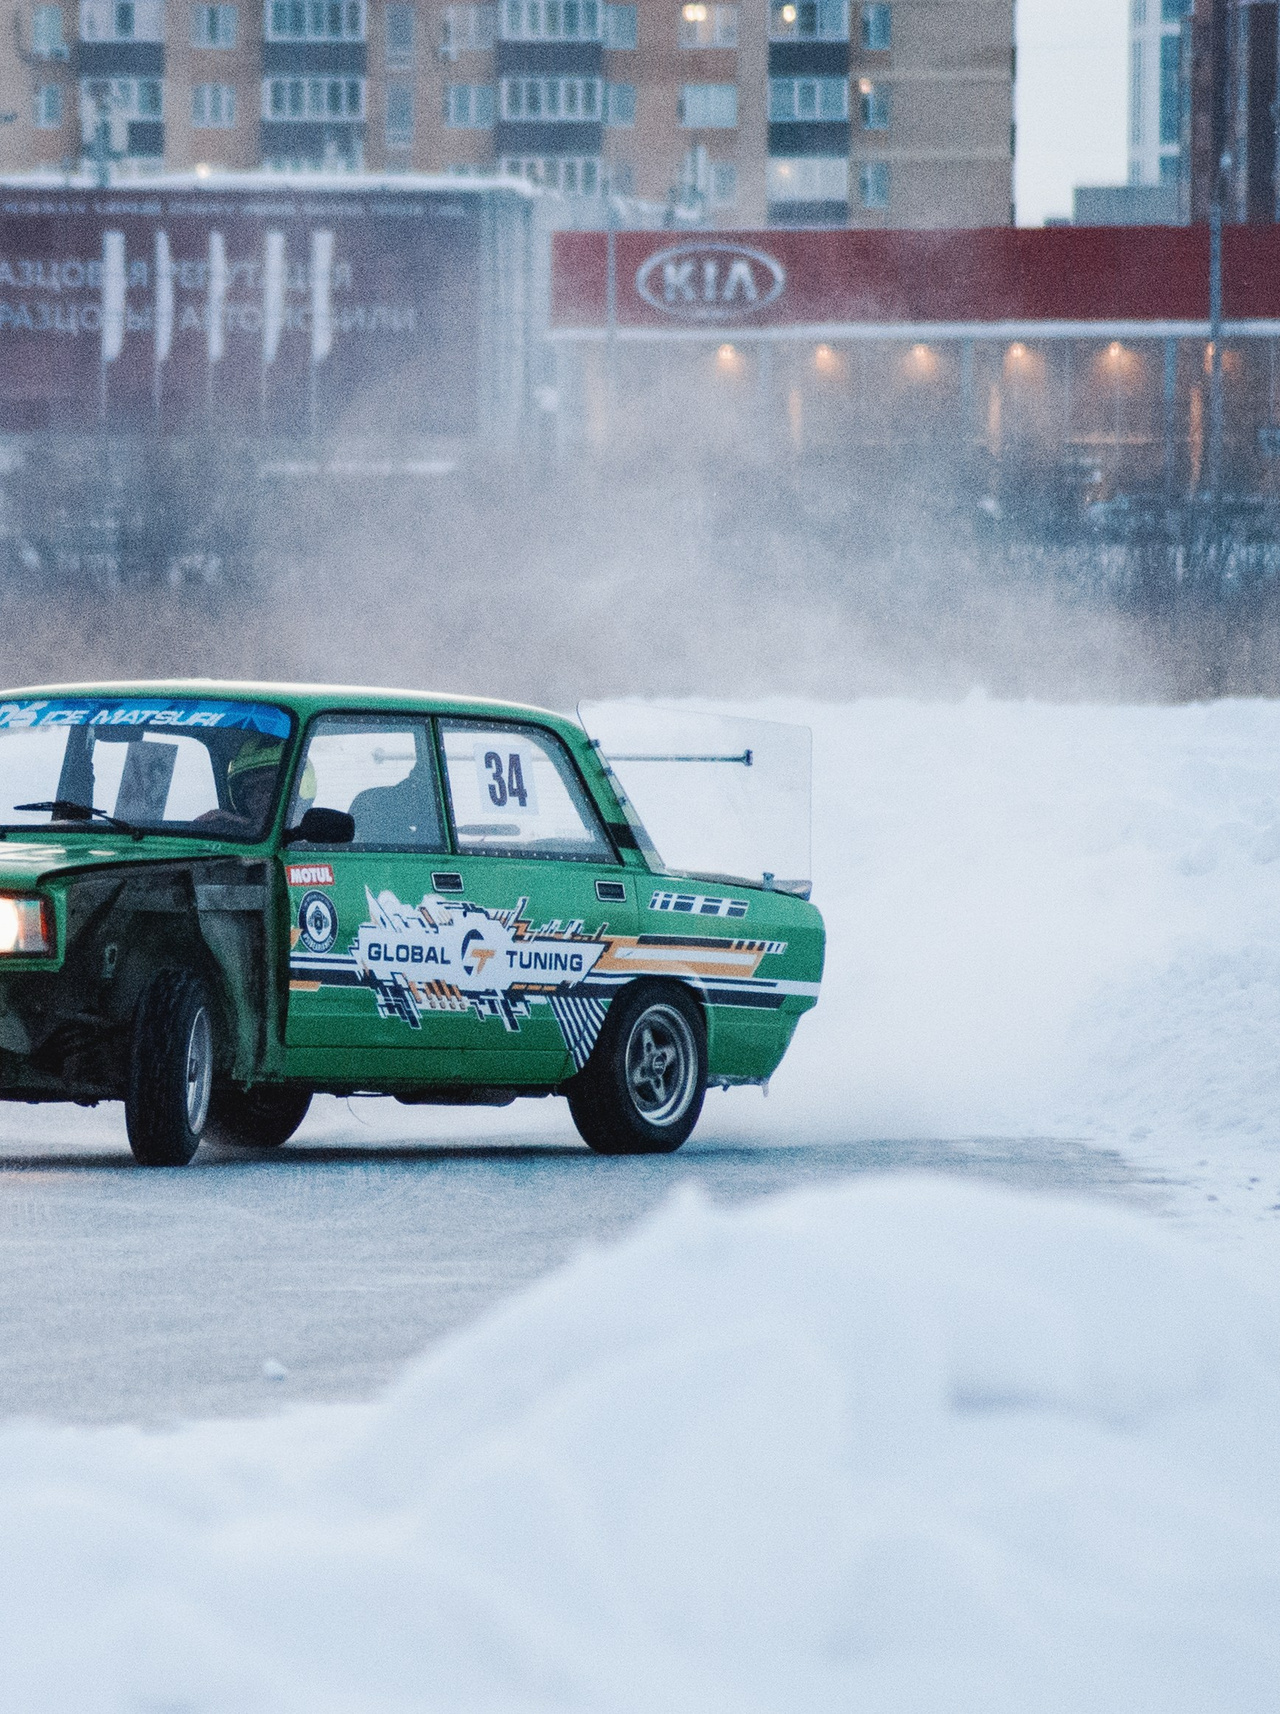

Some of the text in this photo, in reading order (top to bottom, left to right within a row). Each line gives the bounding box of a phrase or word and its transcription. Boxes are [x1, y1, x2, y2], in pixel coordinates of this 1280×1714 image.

[661, 258, 759, 303] KIA
[38, 710, 88, 726] ICE
[89, 709, 226, 727] MATSURI
[484, 751, 528, 807] 34
[290, 867, 333, 884] MOTUL
[368, 943, 451, 965] GLOBAL
[505, 950, 583, 972] TUNING
